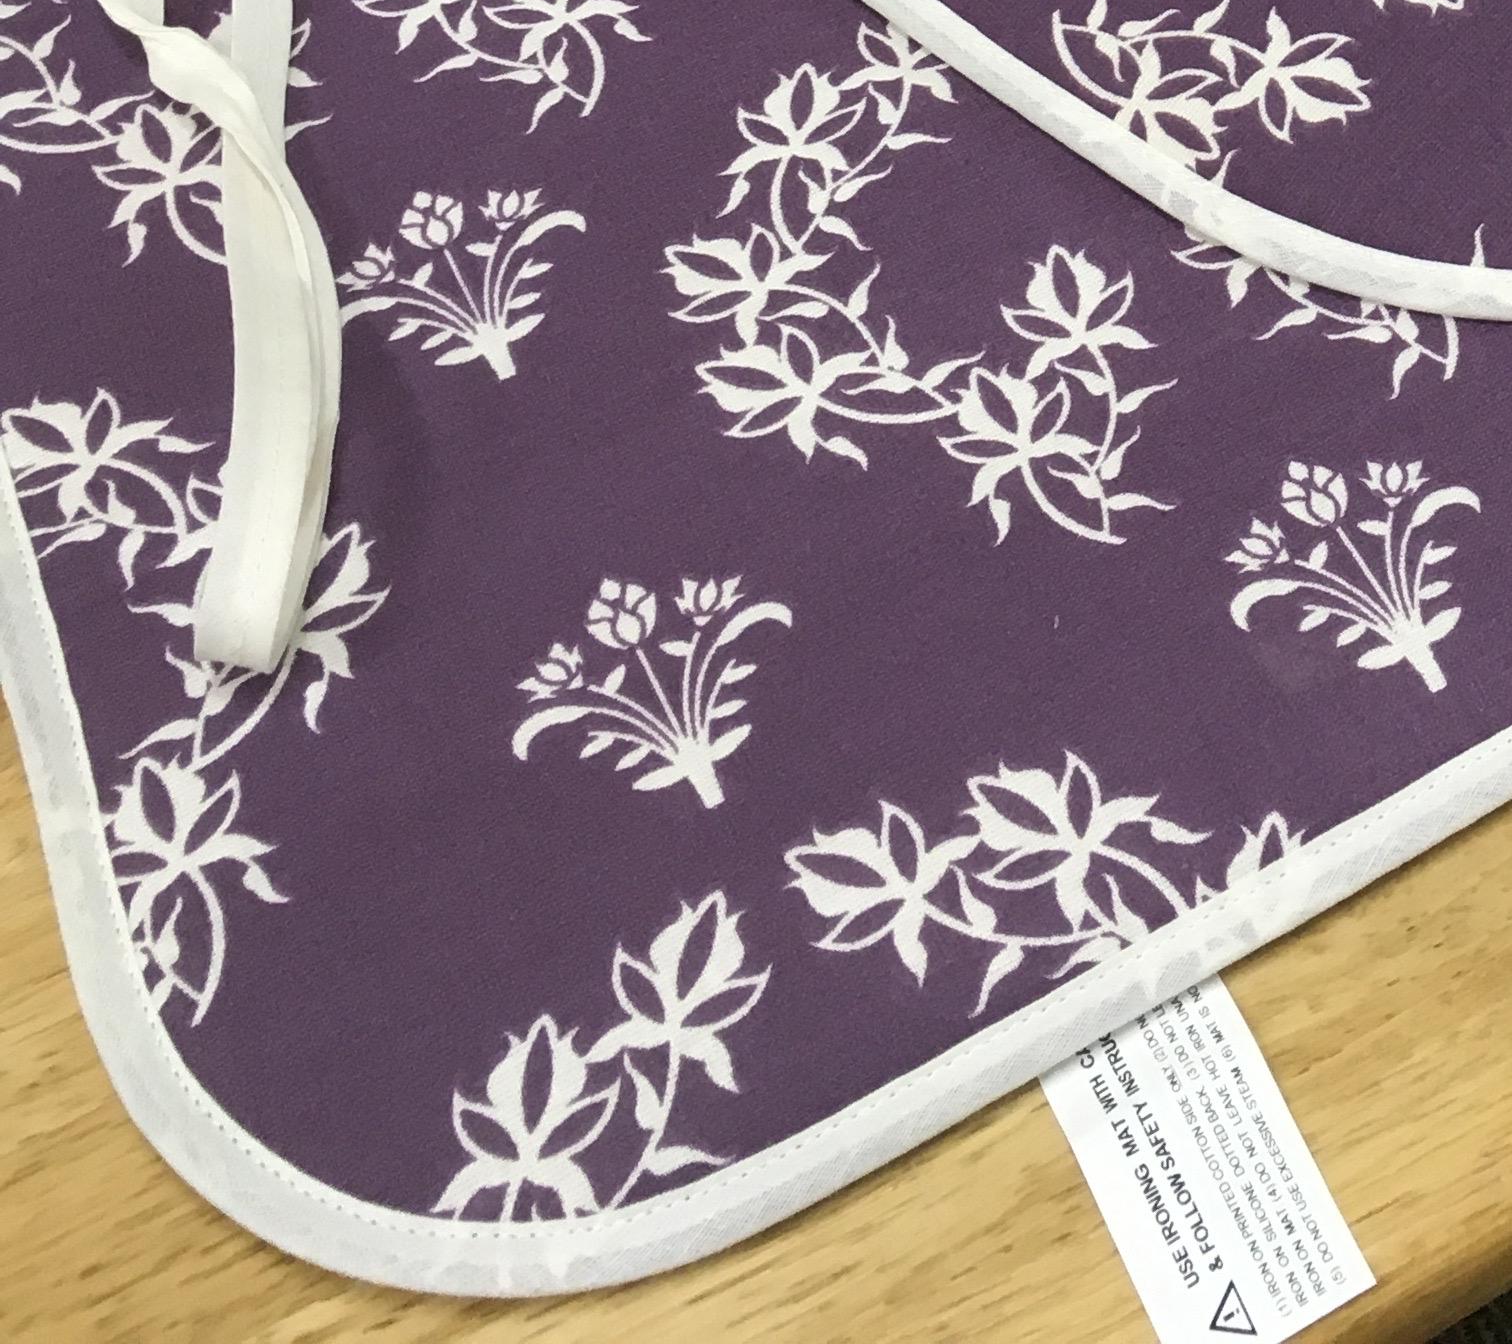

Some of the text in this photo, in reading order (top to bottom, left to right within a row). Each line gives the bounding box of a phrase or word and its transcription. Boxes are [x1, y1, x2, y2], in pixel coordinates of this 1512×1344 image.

[1197, 1004, 1211, 1019] IS
[1142, 1028, 1159, 1049] DO
[1158, 1019, 1178, 1044] NOT
[1184, 1023, 1206, 1052] IRON
[1205, 1021, 1225, 1044] MAT
[1173, 1043, 1190, 1063] DO
[1199, 1053, 1221, 1081] HOT
[1088, 1073, 1118, 1114] WITH
[1161, 1065, 1181, 1093] ONLY
[1229, 1065, 1256, 1110] STEAM
[1176, 1094, 1198, 1125] SIDE
[1194, 1084, 1219, 1124] BACK
[1215, 1083, 1243, 1127] LEAVE
[1110, 1118, 1140, 1157] MAT
[1131, 1101, 1175, 1171] SAFETY
[1212, 1123, 1245, 1178] DOTTED
[1236, 1130, 1258, 1159] NOT
[1250, 1110, 1294, 1183] EXCESSIVE
[1190, 1124, 1224, 1181] COTTON
[1253, 1161, 1271, 1184] DO
[1133, 1162, 1181, 1246] IRONING
[1217, 1180, 1253, 1240] PRINTED
[1240, 1180, 1277, 1242] SILICONE
[1286, 1182, 1307, 1212] USE
[1166, 1172, 1215, 1255] FOLLOW
[1275, 1207, 1296, 1236] MAT
[1300, 1213, 1322, 1241] NOT
[1207, 1254, 1224, 1272] &
[1246, 1238, 1264, 1261] ON
[1272, 1244, 1289, 1267] ON
[1291, 1238, 1309, 1261] ON
[1315, 1240, 1334, 1263] DO
[1171, 1244, 1200, 1289] USE
[1257, 1261, 1281, 1298] IRON
[1302, 1260, 1325, 1296] IRON
[1285, 1270, 1309, 1307] IRON
